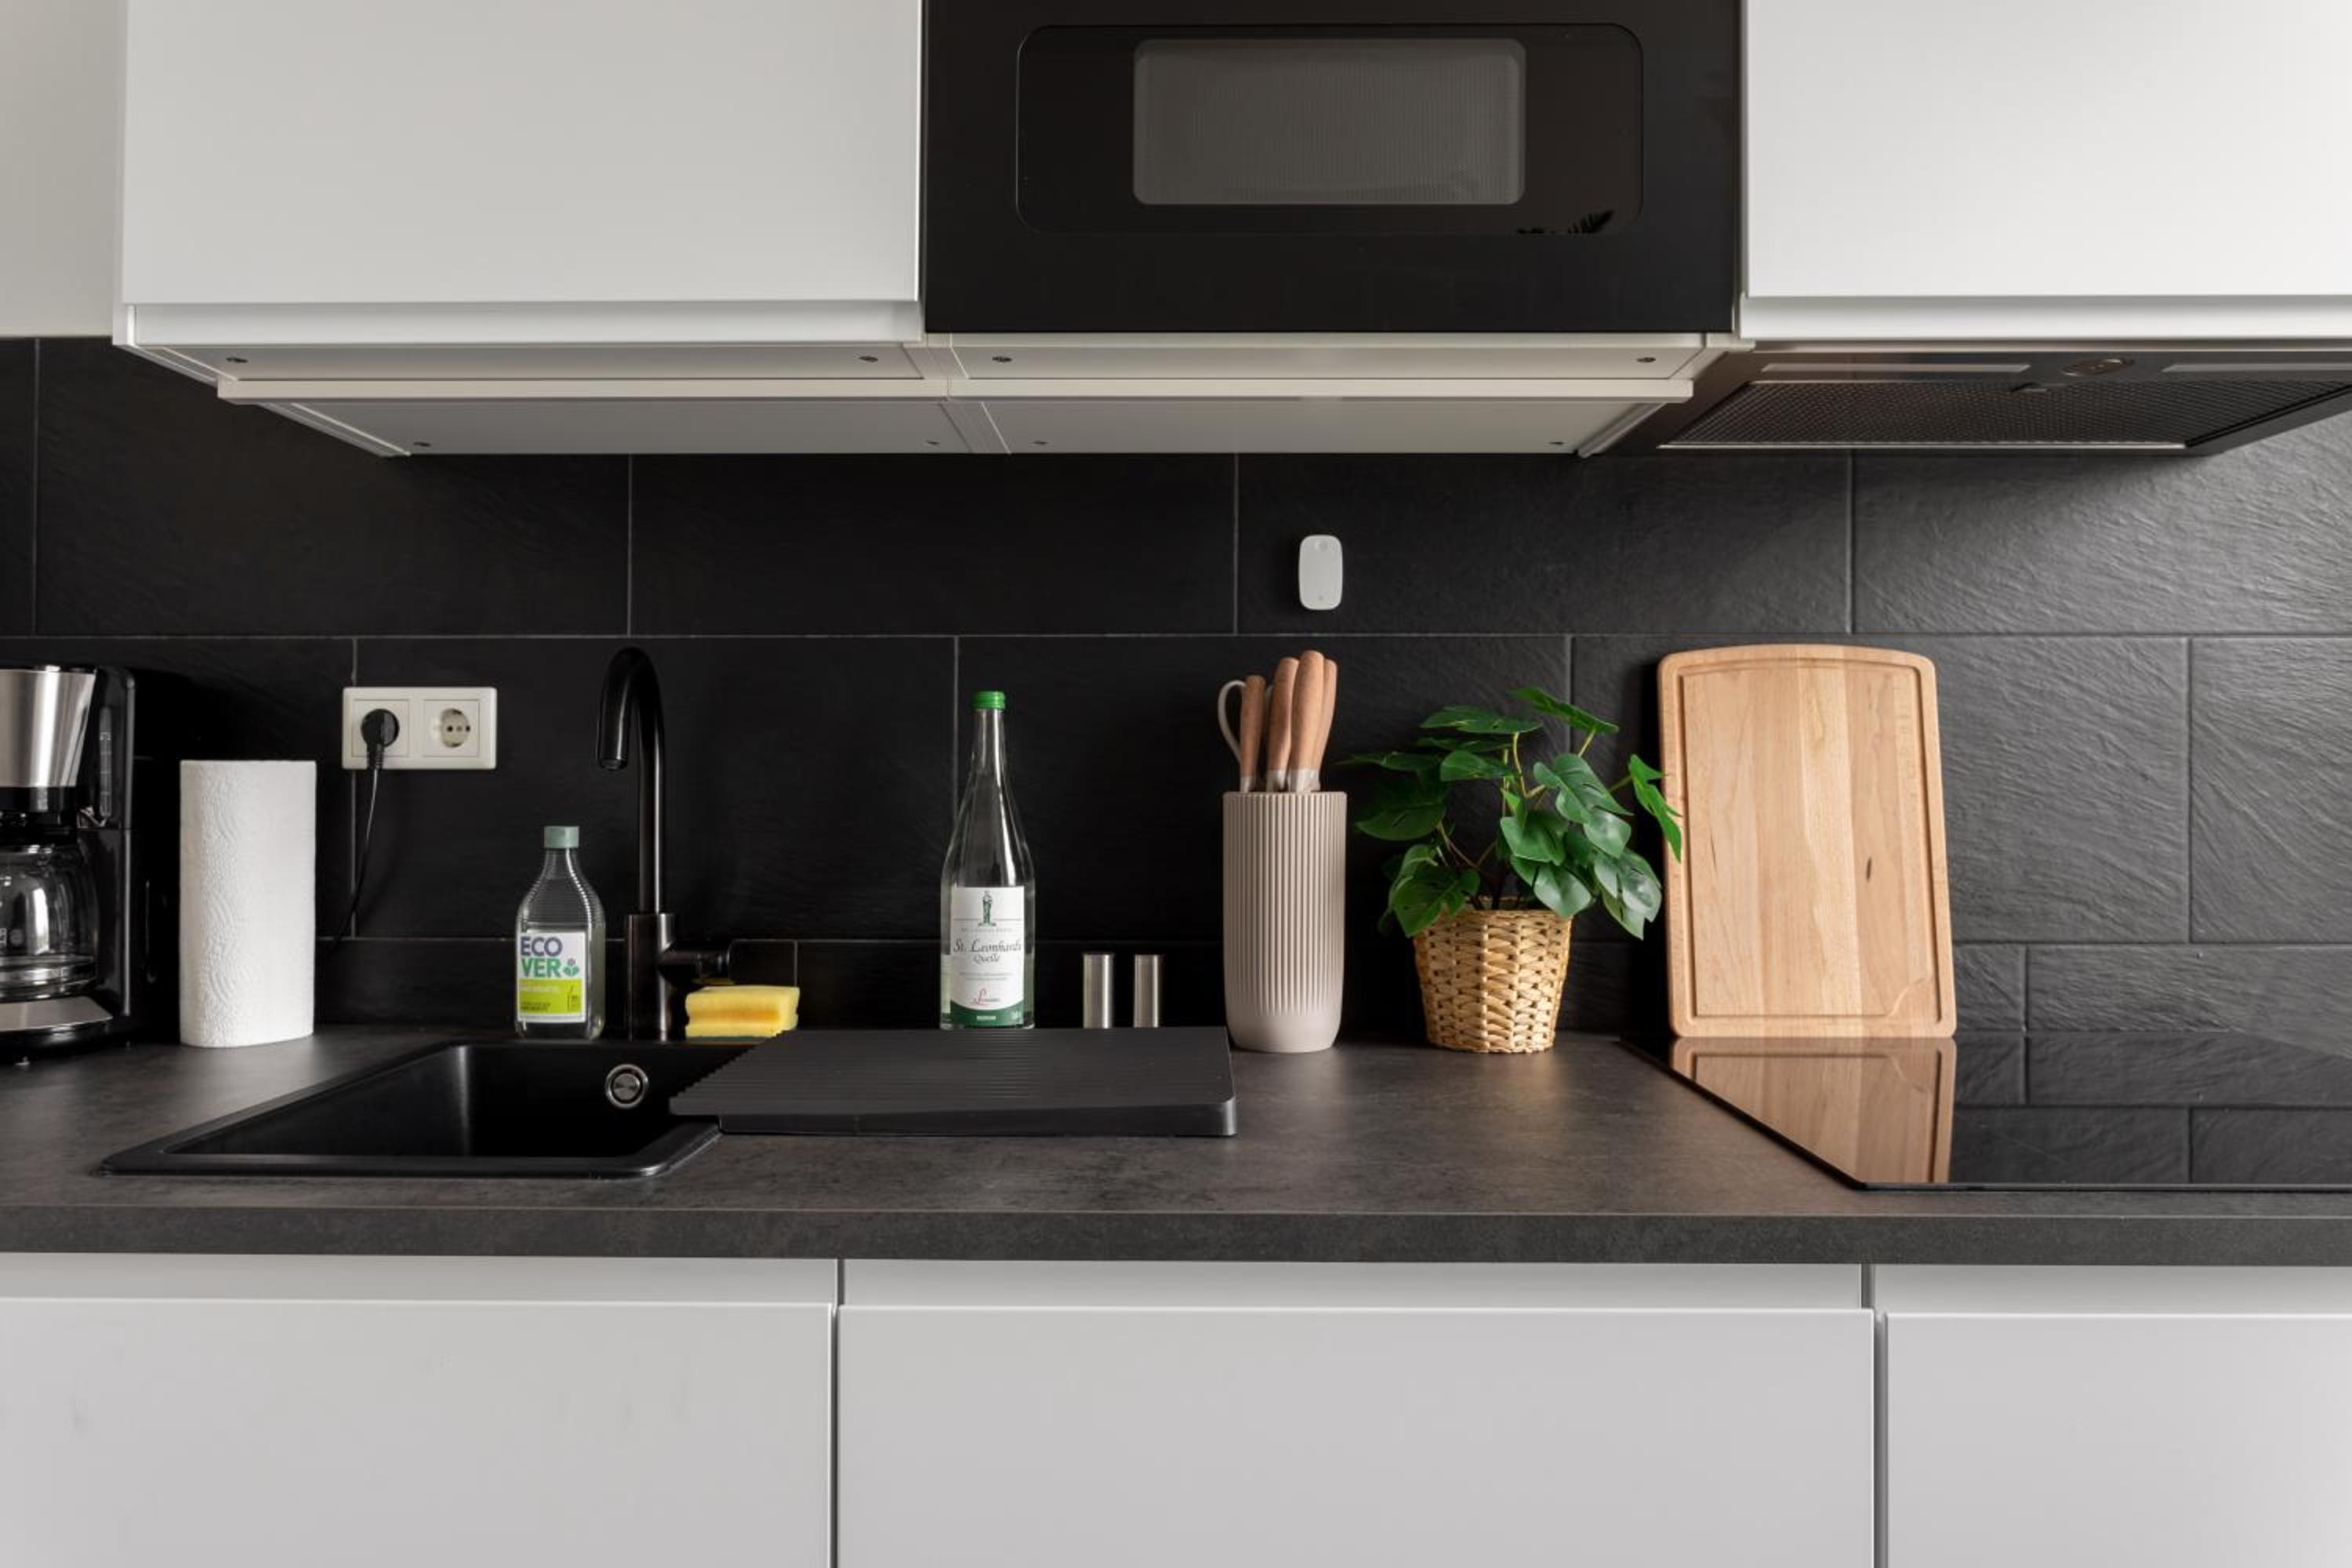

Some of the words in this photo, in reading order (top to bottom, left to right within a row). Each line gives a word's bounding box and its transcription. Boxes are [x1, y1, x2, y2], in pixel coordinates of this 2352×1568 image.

[521, 936, 563, 956] ECO
[953, 938, 967, 953] St.
[521, 957, 561, 978] VER
